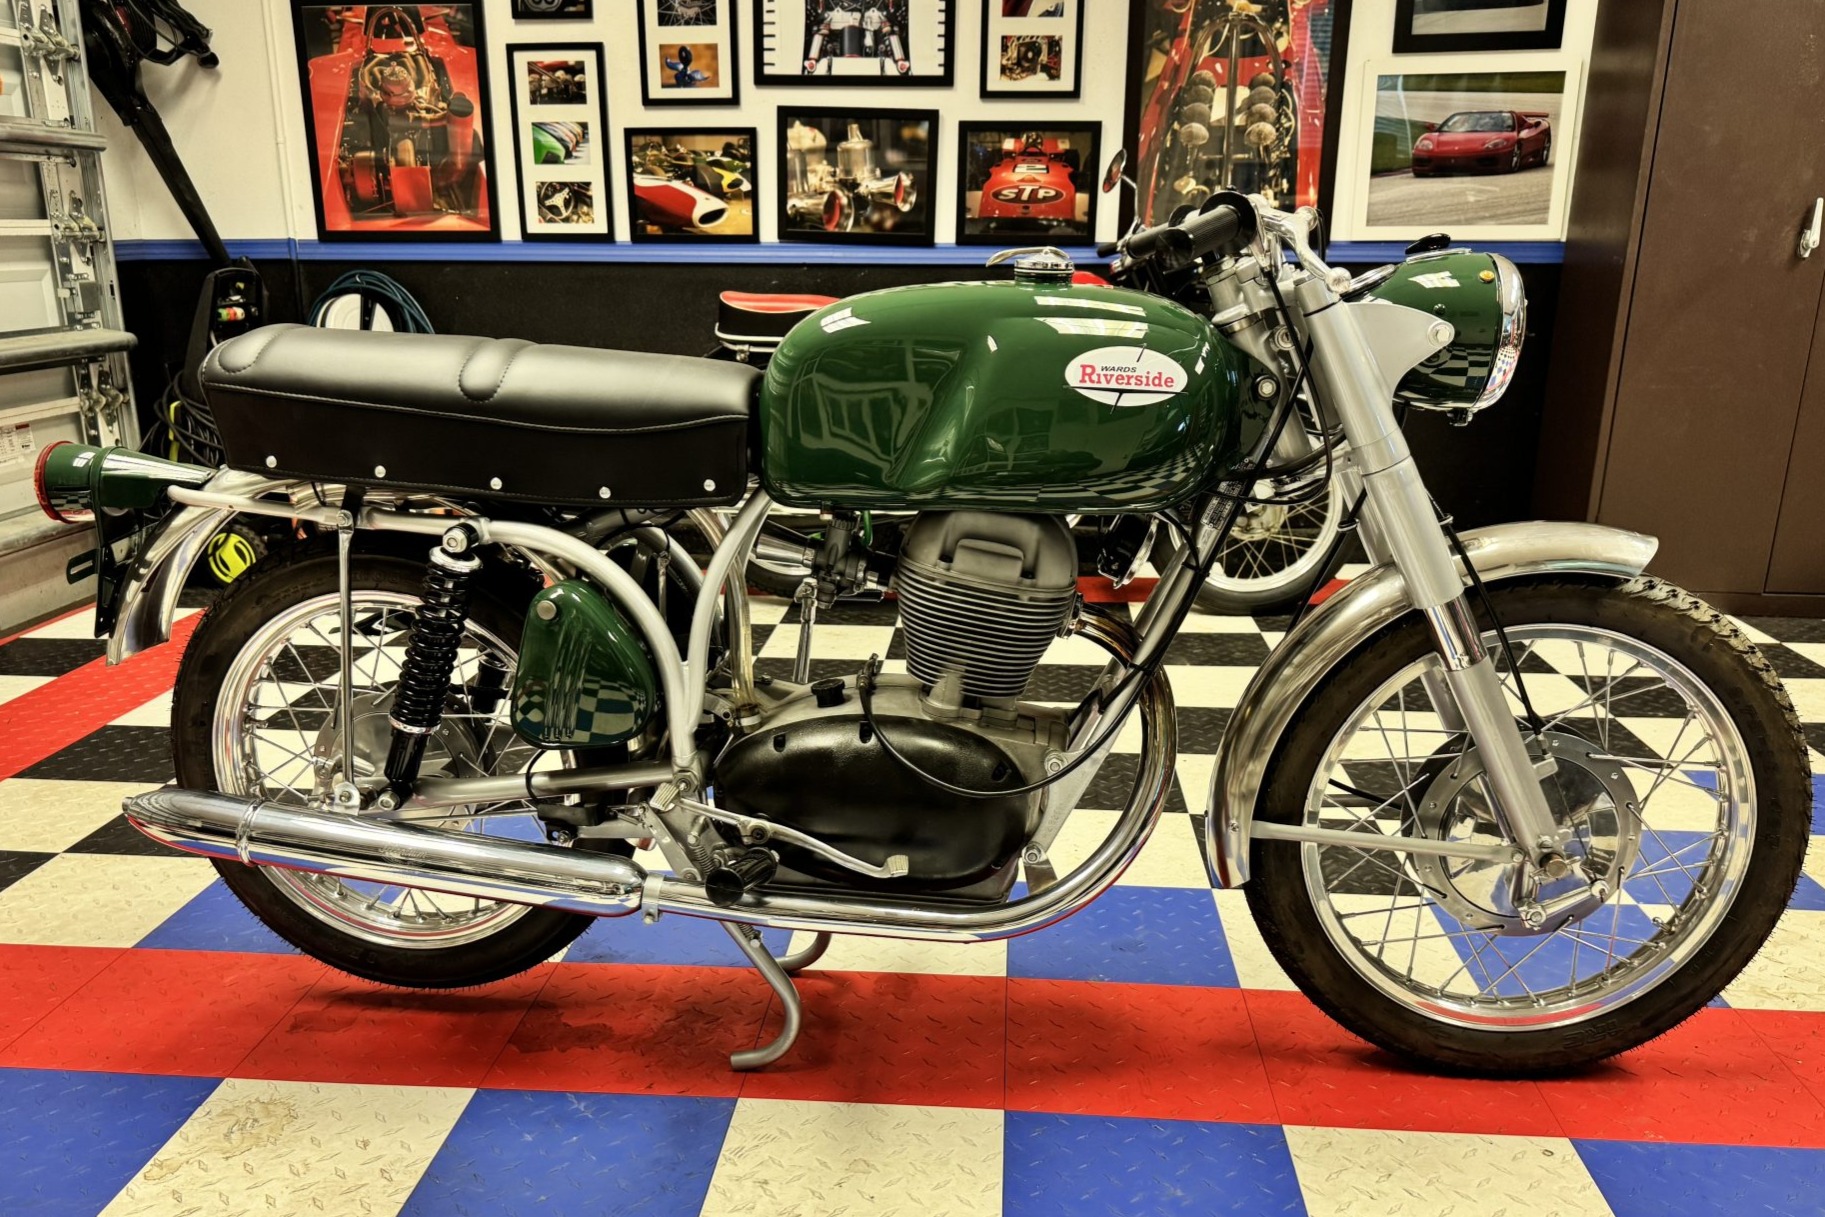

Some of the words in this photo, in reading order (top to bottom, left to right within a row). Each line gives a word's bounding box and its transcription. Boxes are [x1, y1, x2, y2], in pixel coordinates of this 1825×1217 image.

[998, 185, 1056, 201] STP
[1079, 364, 1174, 388] Riverside
[1101, 365, 1137, 373] WARDS
